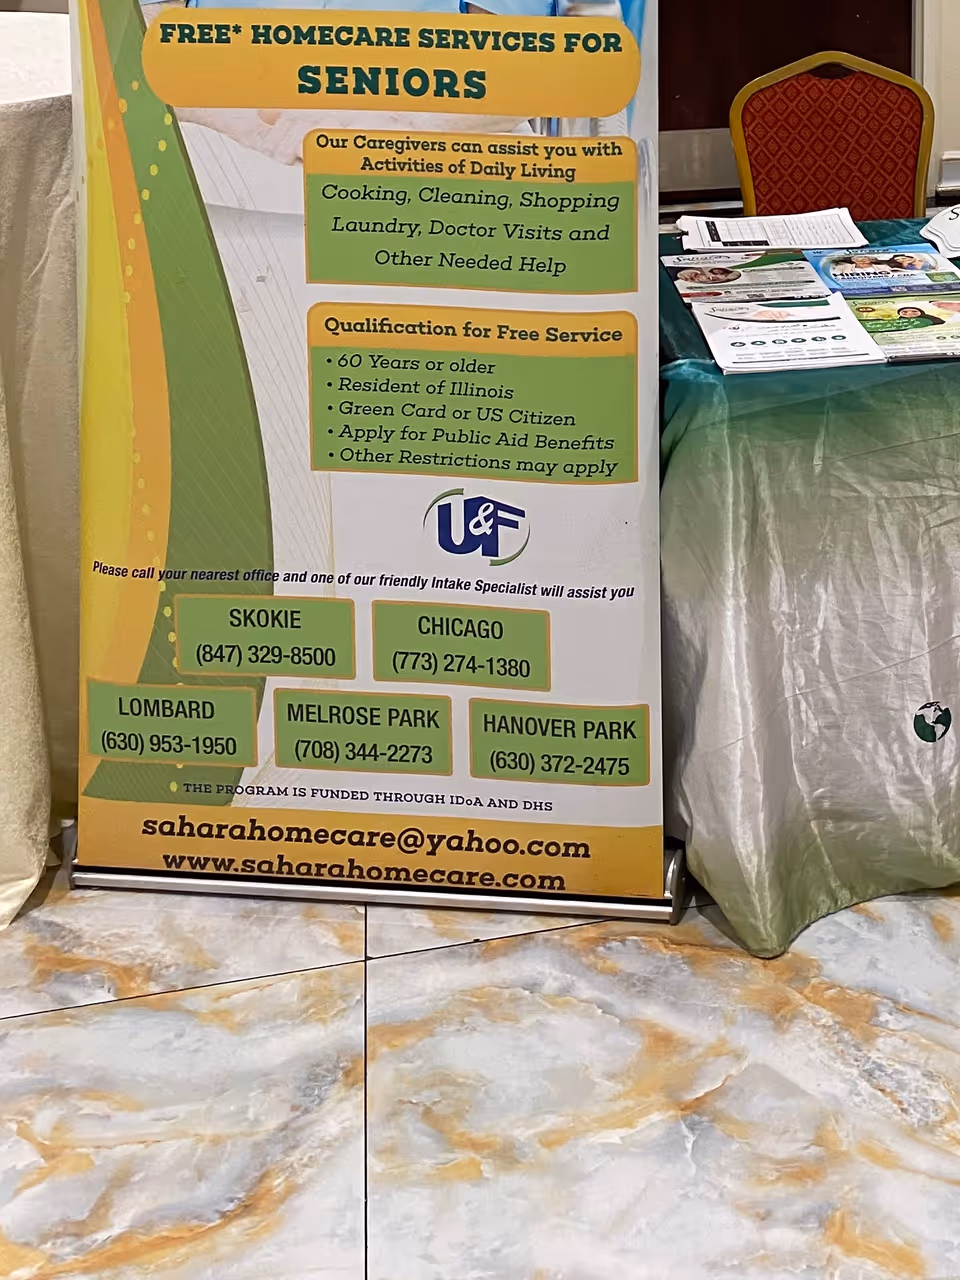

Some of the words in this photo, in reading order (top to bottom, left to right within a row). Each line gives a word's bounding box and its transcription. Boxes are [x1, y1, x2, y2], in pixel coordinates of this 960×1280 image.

[251, 25, 410, 47] HOMECARE
[418, 28, 555, 52] SERVICES
[564, 33, 622, 53] FOR
[298, 66, 486, 99] SENIORS
[316, 134, 348, 148] Our
[354, 135, 446, 154] Caregivers
[452, 142, 483, 153] can
[488, 141, 539, 156] assist
[544, 146, 577, 160] you
[582, 142, 622, 156] with
[360, 157, 443, 173] Activities
[448, 159, 466, 174] of
[470, 161, 516, 180] Daily
[521, 163, 576, 182] Living
[322, 184, 411, 205] Cooking,
[419, 187, 512, 210] Cleaning,
[520, 192, 619, 212] Shopping
[332, 217, 421, 238] Laundry,
[428, 220, 496, 237] Doctor
[503, 224, 562, 240] Visits
[569, 225, 609, 240] and
[375, 250, 433, 266] Other
[438, 253, 512, 270] Needed
[519, 257, 566, 276] Help
[325, 317, 457, 336] Qualification
[462, 322, 491, 338] for
[497, 325, 539, 341] Free
[546, 327, 622, 342] Service
[338, 354, 362, 367] 60
[369, 355, 420, 370] Years
[426, 361, 444, 370] or
[450, 358, 496, 374] older
[338, 378, 420, 393] Resident
[426, 380, 446, 394] of
[450, 382, 514, 399] Illinois
[340, 401, 394, 416] Green
[402, 403, 446, 418] Card
[452, 410, 471, 420] or
[477, 407, 503, 422] US
[509, 410, 576, 426] Citizen
[338, 424, 395, 443] Apply
[400, 426, 427, 440] for
[432, 428, 491, 444] Public
[495, 432, 528, 447] Aid
[534, 435, 614, 450] Benefits
[340, 448, 394, 462] Other
[398, 450, 510, 469] Restrictions
[516, 461, 558, 476] may
[564, 459, 618, 477] apply
[93, 561, 128, 577] Please
[132, 567, 154, 578] call
[158, 570, 187, 581] your
[190, 570, 239, 580] nearest
[243, 568, 279, 583] office
[283, 571, 307, 582] and
[311, 574, 334, 583] one
[338, 573, 351, 584] of
[354, 576, 376, 585] our
[380, 574, 428, 590] friendly
[432, 577, 471, 590] Intake
[475, 580, 537, 595] Specialist
[541, 585, 564, 597] will
[567, 587, 607, 598] assist
[610, 587, 634, 600] you
[230, 609, 301, 628] SKOKIE
[418, 616, 503, 639] CHICAGO
[197, 644, 242, 667] (847)
[248, 646, 335, 666] 329-8500
[393, 651, 437, 675] (773)
[444, 654, 530, 677] 274-1380
[119, 697, 214, 718] LOMBARD
[288, 704, 380, 725] MELROSE
[389, 708, 440, 728] PARK
[484, 714, 576, 738] HANOVER
[584, 721, 636, 739] PARK
[102, 731, 144, 755] (630)
[150, 735, 236, 755] 953-1950
[295, 740, 339, 763] (708)
[346, 742, 432, 763] 344-2273
[490, 750, 535, 775] (630)
[541, 754, 629, 775] 372-2475
[183, 784, 211, 793] THE
[216, 783, 289, 797] PROGRAM
[293, 788, 306, 797] IS
[311, 788, 368, 800] FUNDED
[374, 792, 445, 804] THROUGH
[487, 798, 518, 808] AND
[523, 801, 552, 811] DHS
[142, 815, 591, 858] saharahomecare@yahoo.com
[162, 854, 566, 890] www.saharahomecare.com
